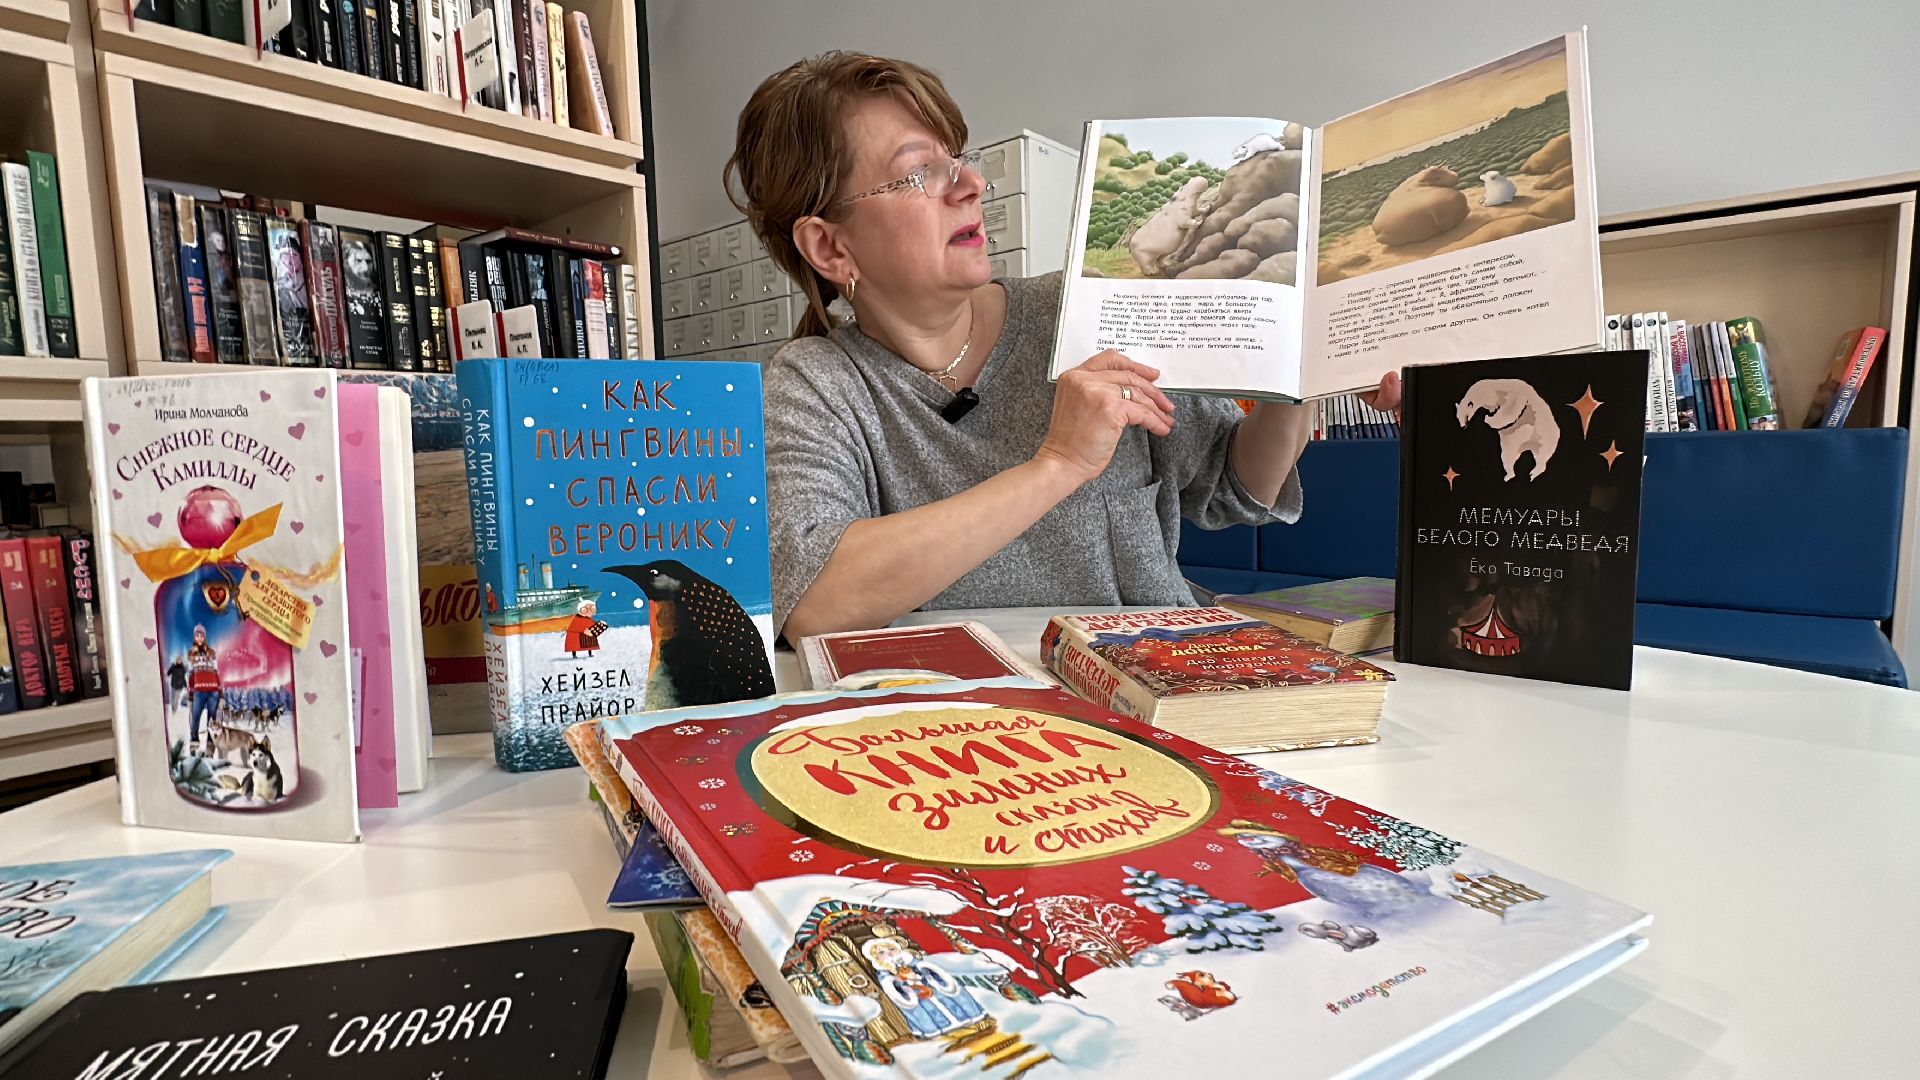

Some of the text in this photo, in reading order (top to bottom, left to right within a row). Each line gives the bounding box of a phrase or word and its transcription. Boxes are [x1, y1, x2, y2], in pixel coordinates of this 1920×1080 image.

[510, 331, 532, 342] Платонов
[1748, 359, 1766, 396] КОЛЬЦУ
[603, 379, 677, 412] КАК
[154, 404, 249, 422] Ирина Молчанова
[115, 428, 296, 482] СНЕЖНОЕ СЕРДЦЕ
[535, 427, 741, 460] ПИНГВИНЫ
[152, 460, 257, 493] КАМИЛЛЫ
[462, 398, 485, 566] СПАСЛИ ВЕРОНИКУ
[476, 408, 499, 551] КАК ПИНГВИНЫ
[566, 473, 718, 508] СПАСЛИ
[1459, 507, 1581, 528] МЕМУАРЫ
[548, 517, 737, 557] ВЕРОНИКУ
[1416, 528, 1629, 553] БЕЛОГО МЕДВЕДЯ
[1469, 557, 1563, 583] Ёко Тавада
[1087, 613, 1243, 631] ДЕТЕКТИВ
[1171, 644, 1267, 657] ДОНЦОВА
[1186, 658, 1216, 667] Дед
[1222, 655, 1276, 663] Снегур
[1188, 642, 1229, 650] Дарья
[21, 650, 47, 697] ДОКТОР
[541, 666, 632, 695] ХЕЙЗЕЛ
[1202, 660, 1292, 670] Морозочка
[492, 642, 509, 723] ХЕЙЗЕЛ
[541, 697, 636, 726] ПРАЙОР
[766, 714, 1046, 757] Большая
[803, 729, 1122, 796] КНИГА
[995, 789, 1141, 828] сказок
[984, 799, 1191, 855] и стихов
[1326, 966, 1428, 1015] #эксмодетство
[73, 996, 513, 1080] МЯТНАЯ СКАЗКА
